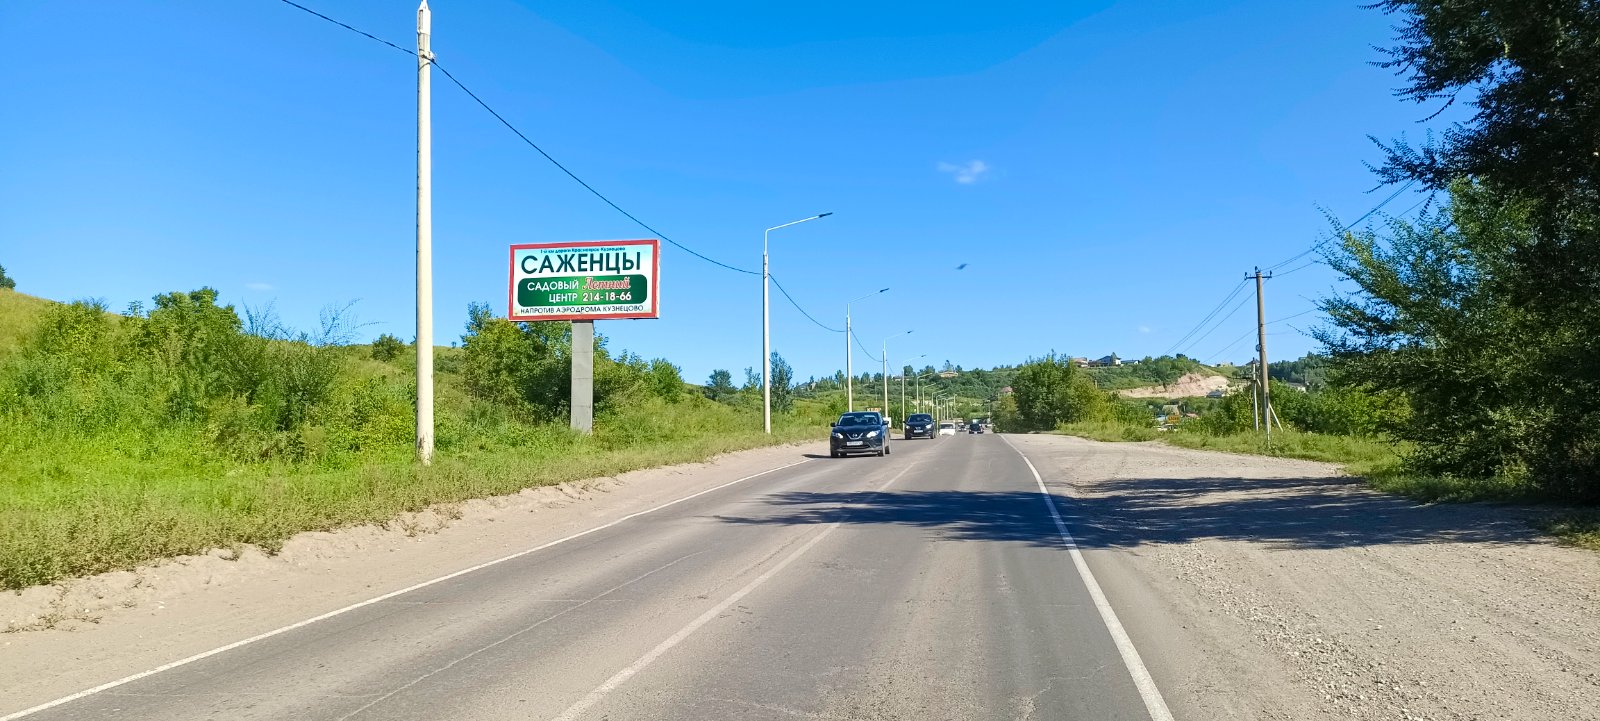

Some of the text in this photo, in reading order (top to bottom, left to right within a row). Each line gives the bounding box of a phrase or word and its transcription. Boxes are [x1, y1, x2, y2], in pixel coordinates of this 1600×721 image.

[521, 251, 641, 274] САЖЕНЦЫ
[527, 276, 632, 292] САДОВЫЙ Летний
[548, 291, 632, 303] ЦЕНТР 214-18-66
[520, 304, 644, 314] НАПРОТИВ АЭРОДРОМА КУЗНЕЦОВО
